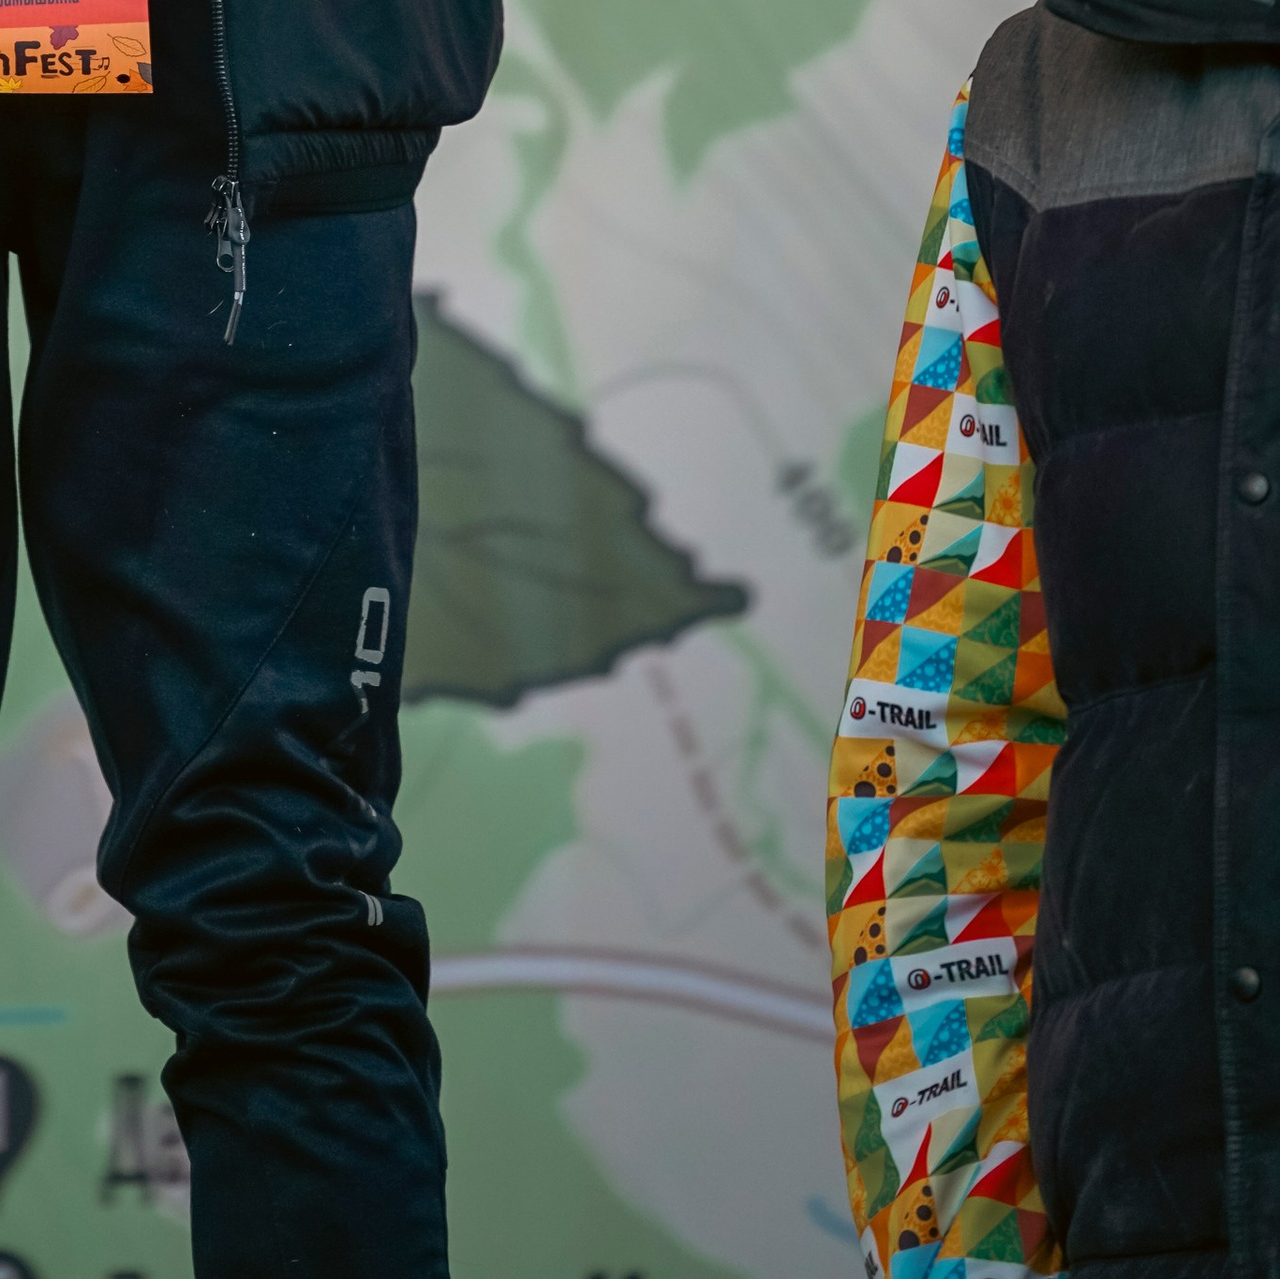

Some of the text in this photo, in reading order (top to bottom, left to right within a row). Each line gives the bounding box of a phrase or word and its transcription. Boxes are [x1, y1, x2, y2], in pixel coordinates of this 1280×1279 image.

[850, 696, 937, 730] O-TRAIL
[907, 954, 1009, 990] O-TRAIL
[891, 1069, 967, 1118] O-TRAIL
